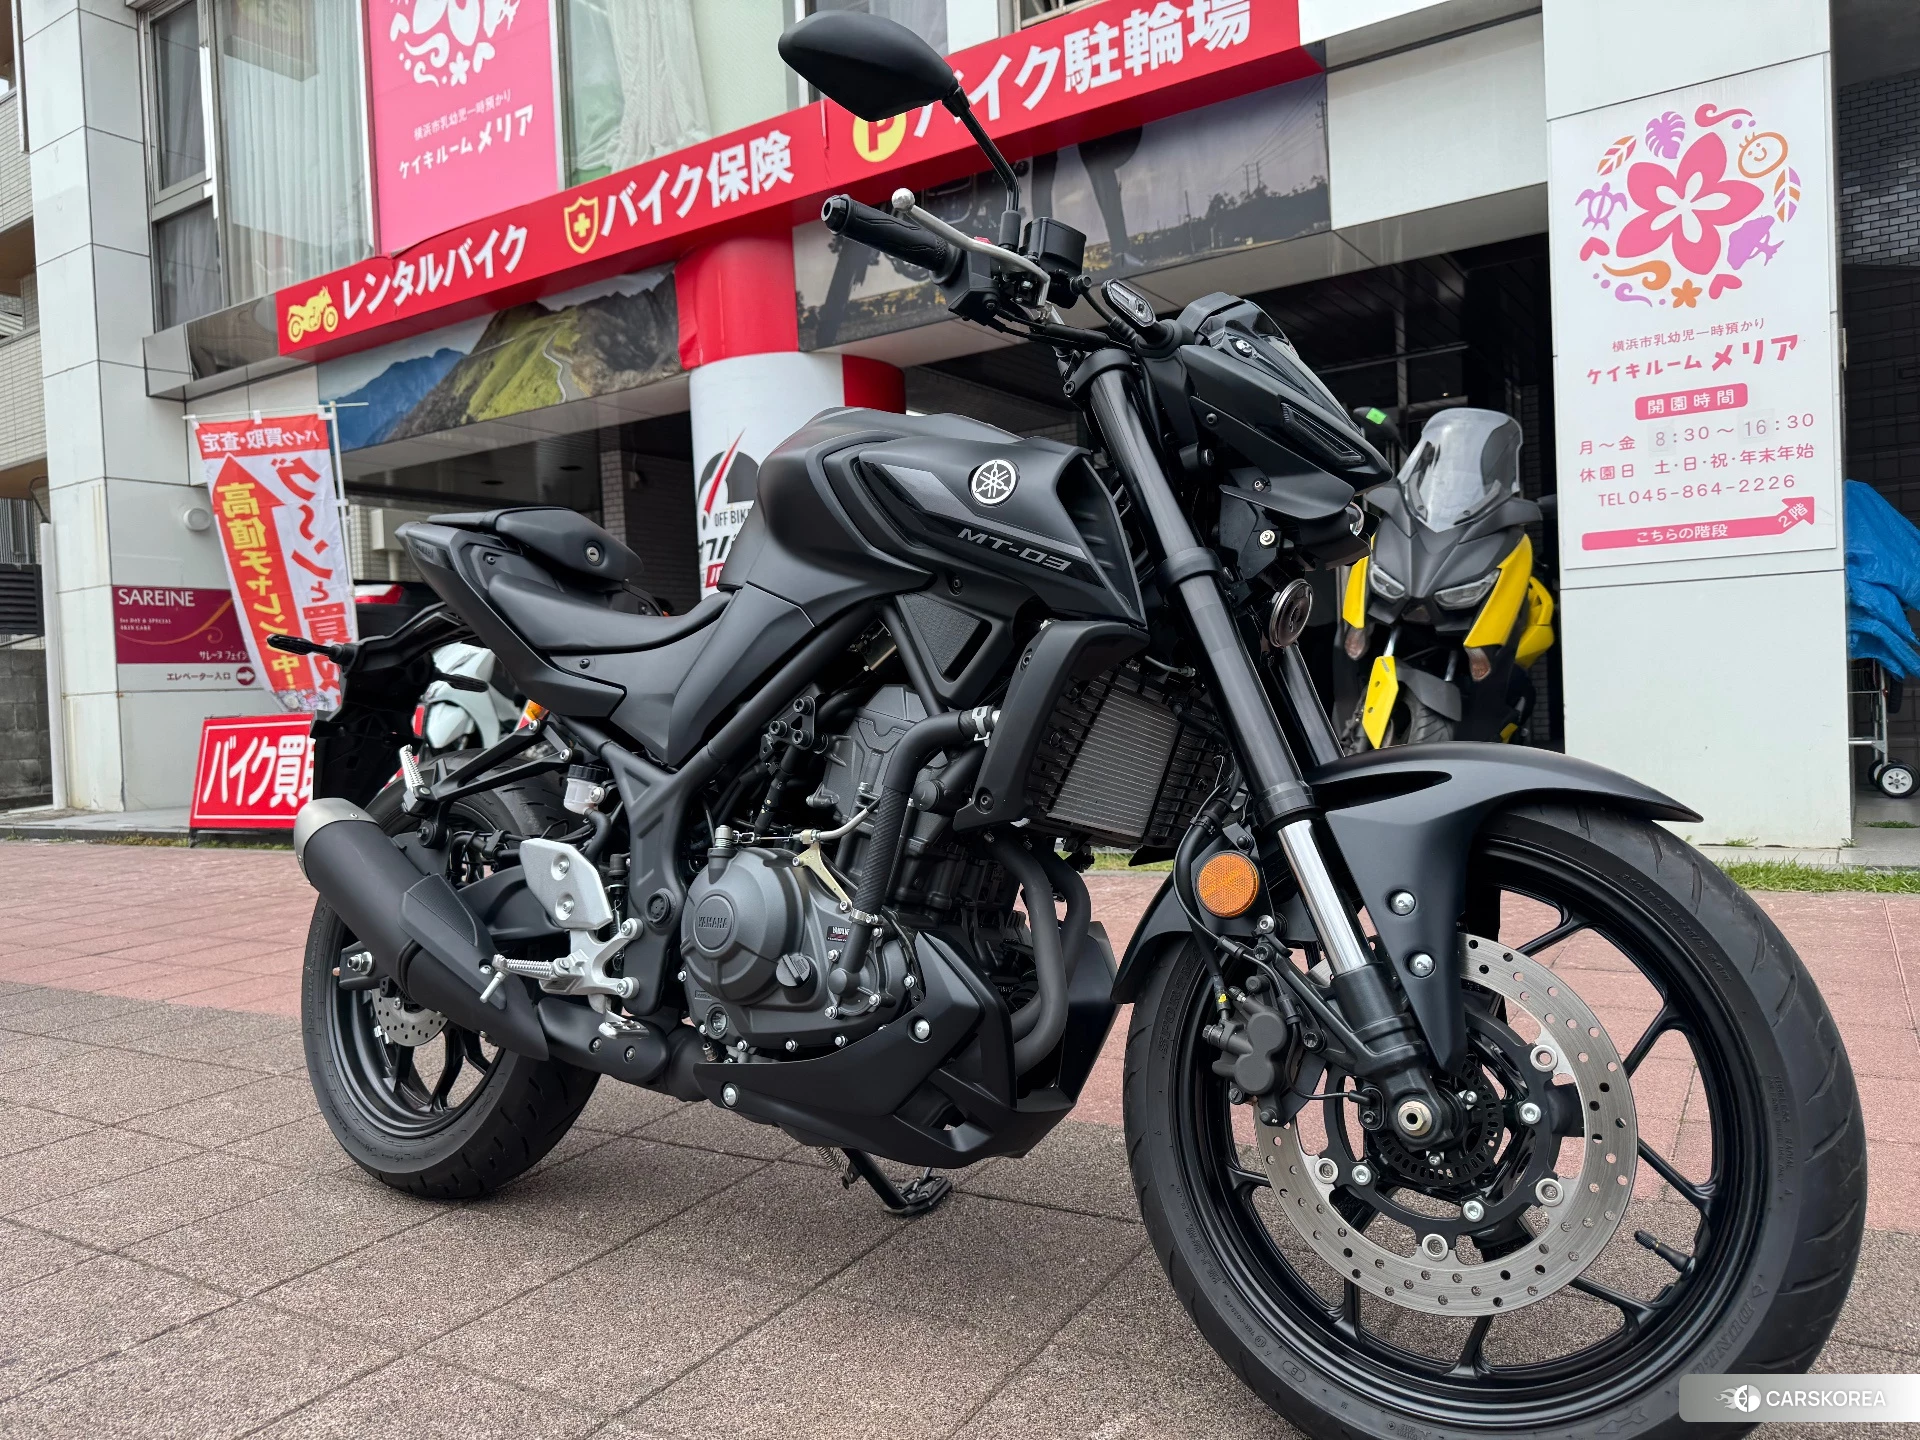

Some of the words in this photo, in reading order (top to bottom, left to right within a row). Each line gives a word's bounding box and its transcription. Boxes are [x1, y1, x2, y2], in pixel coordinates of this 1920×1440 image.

[413, 88, 511, 142] 横浜市乳幼児一時預かり
[601, 129, 795, 237] バイク保険
[342, 223, 528, 320] レンタルバイク
[1611, 317, 1765, 353] 横浜市乳幼児一時預かり
[1647, 388, 1735, 415] 開園時間
[1579, 463, 1634, 483] 休園日
[1653, 442, 1815, 476] 土・日・祝・年末年始
[714, 511, 729, 527] OFF
[1777, 502, 1809, 528] 2階
[1636, 523, 1729, 544] こちらの階段
[957, 528, 1073, 572] MT-03
[118, 588, 196, 607] SAREINE
[166, 671, 231, 682] エレベーター入口
